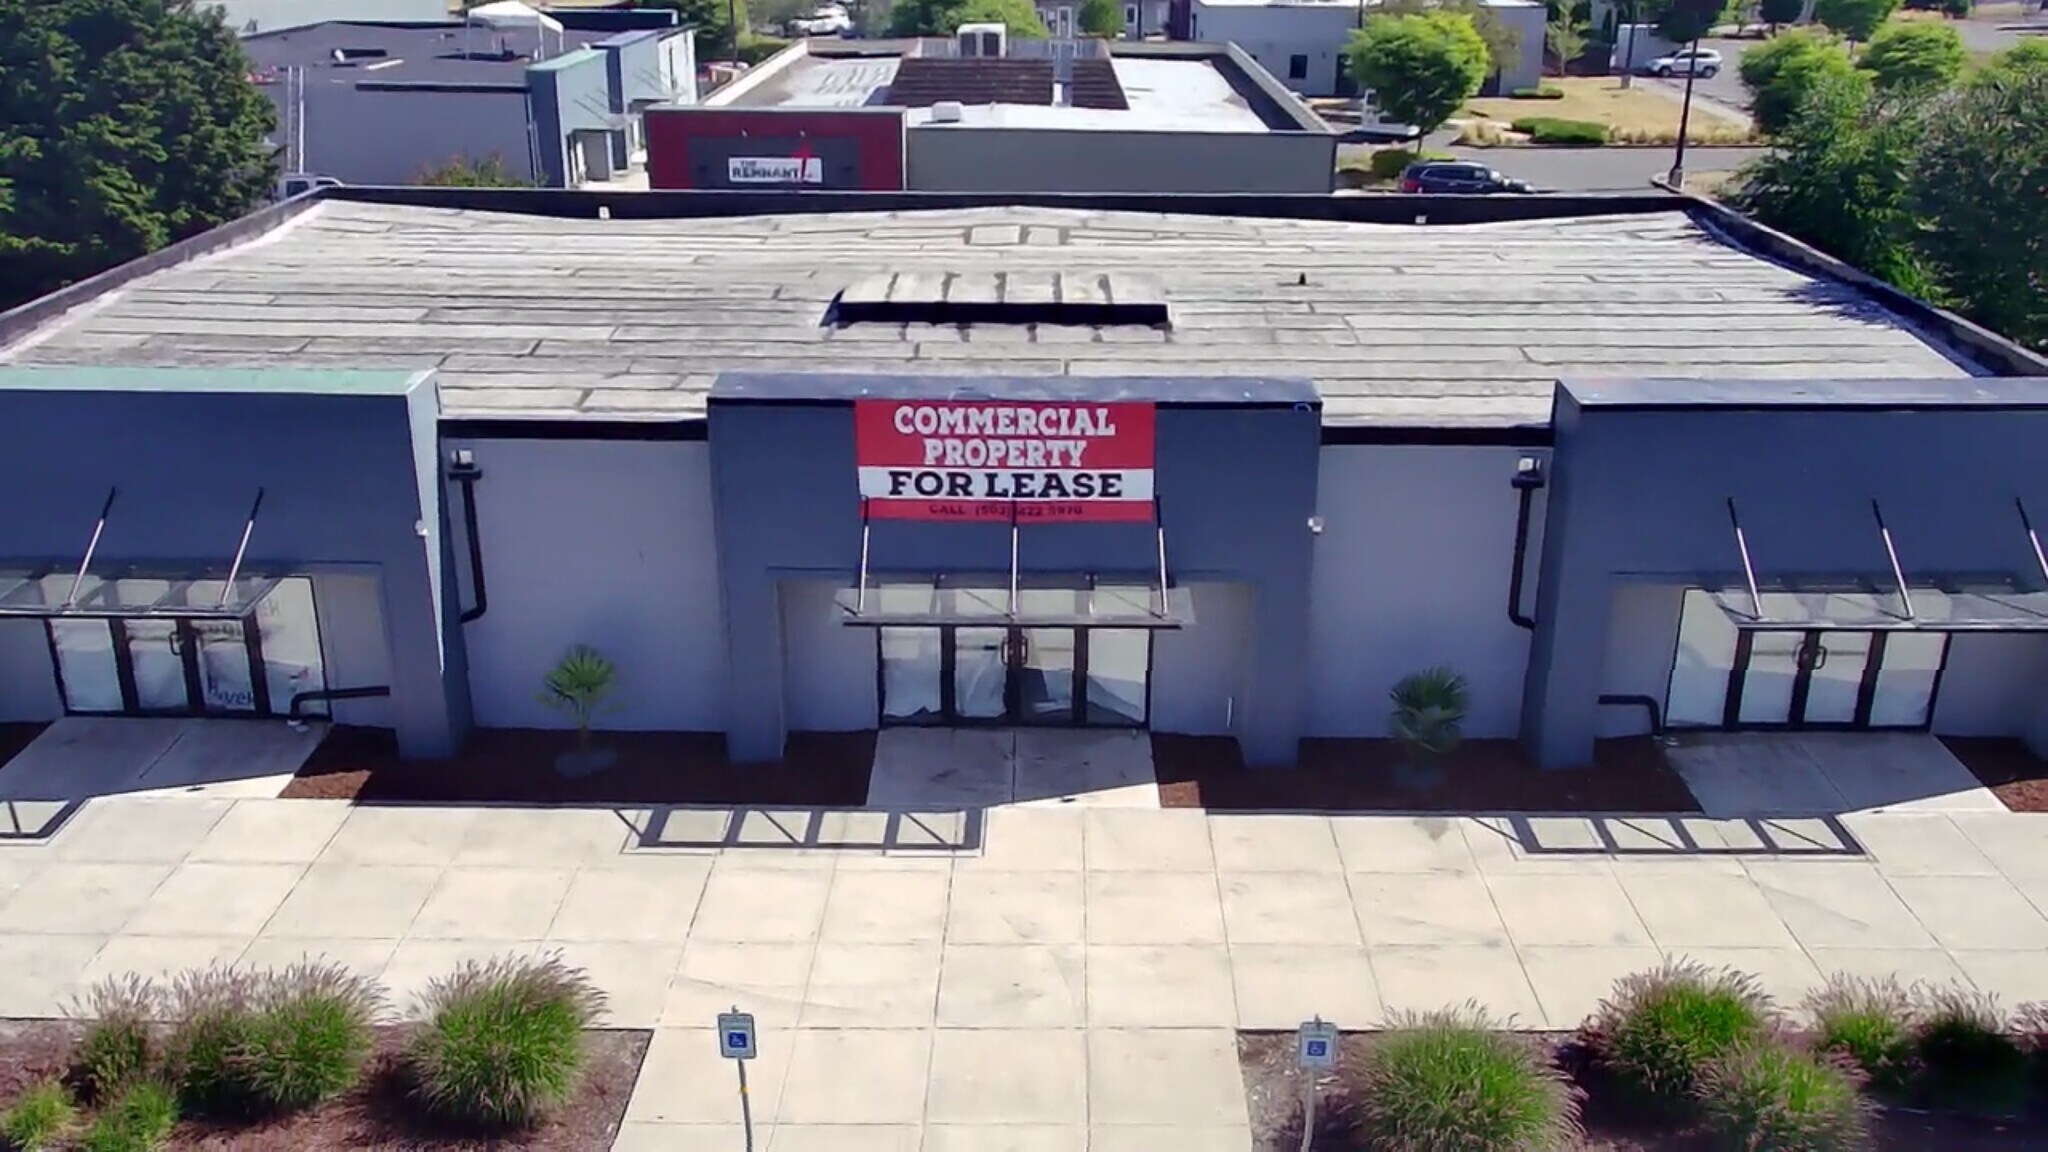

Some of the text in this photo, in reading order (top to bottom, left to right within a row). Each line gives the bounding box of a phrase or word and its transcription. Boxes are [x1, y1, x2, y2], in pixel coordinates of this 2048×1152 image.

[732, 167, 800, 178] REMNANT
[894, 405, 1116, 436] COMMERCIAL
[923, 438, 1088, 467] PROPERTY
[889, 471, 1124, 498] FOR LEASE
[928, 504, 966, 515] CALL
